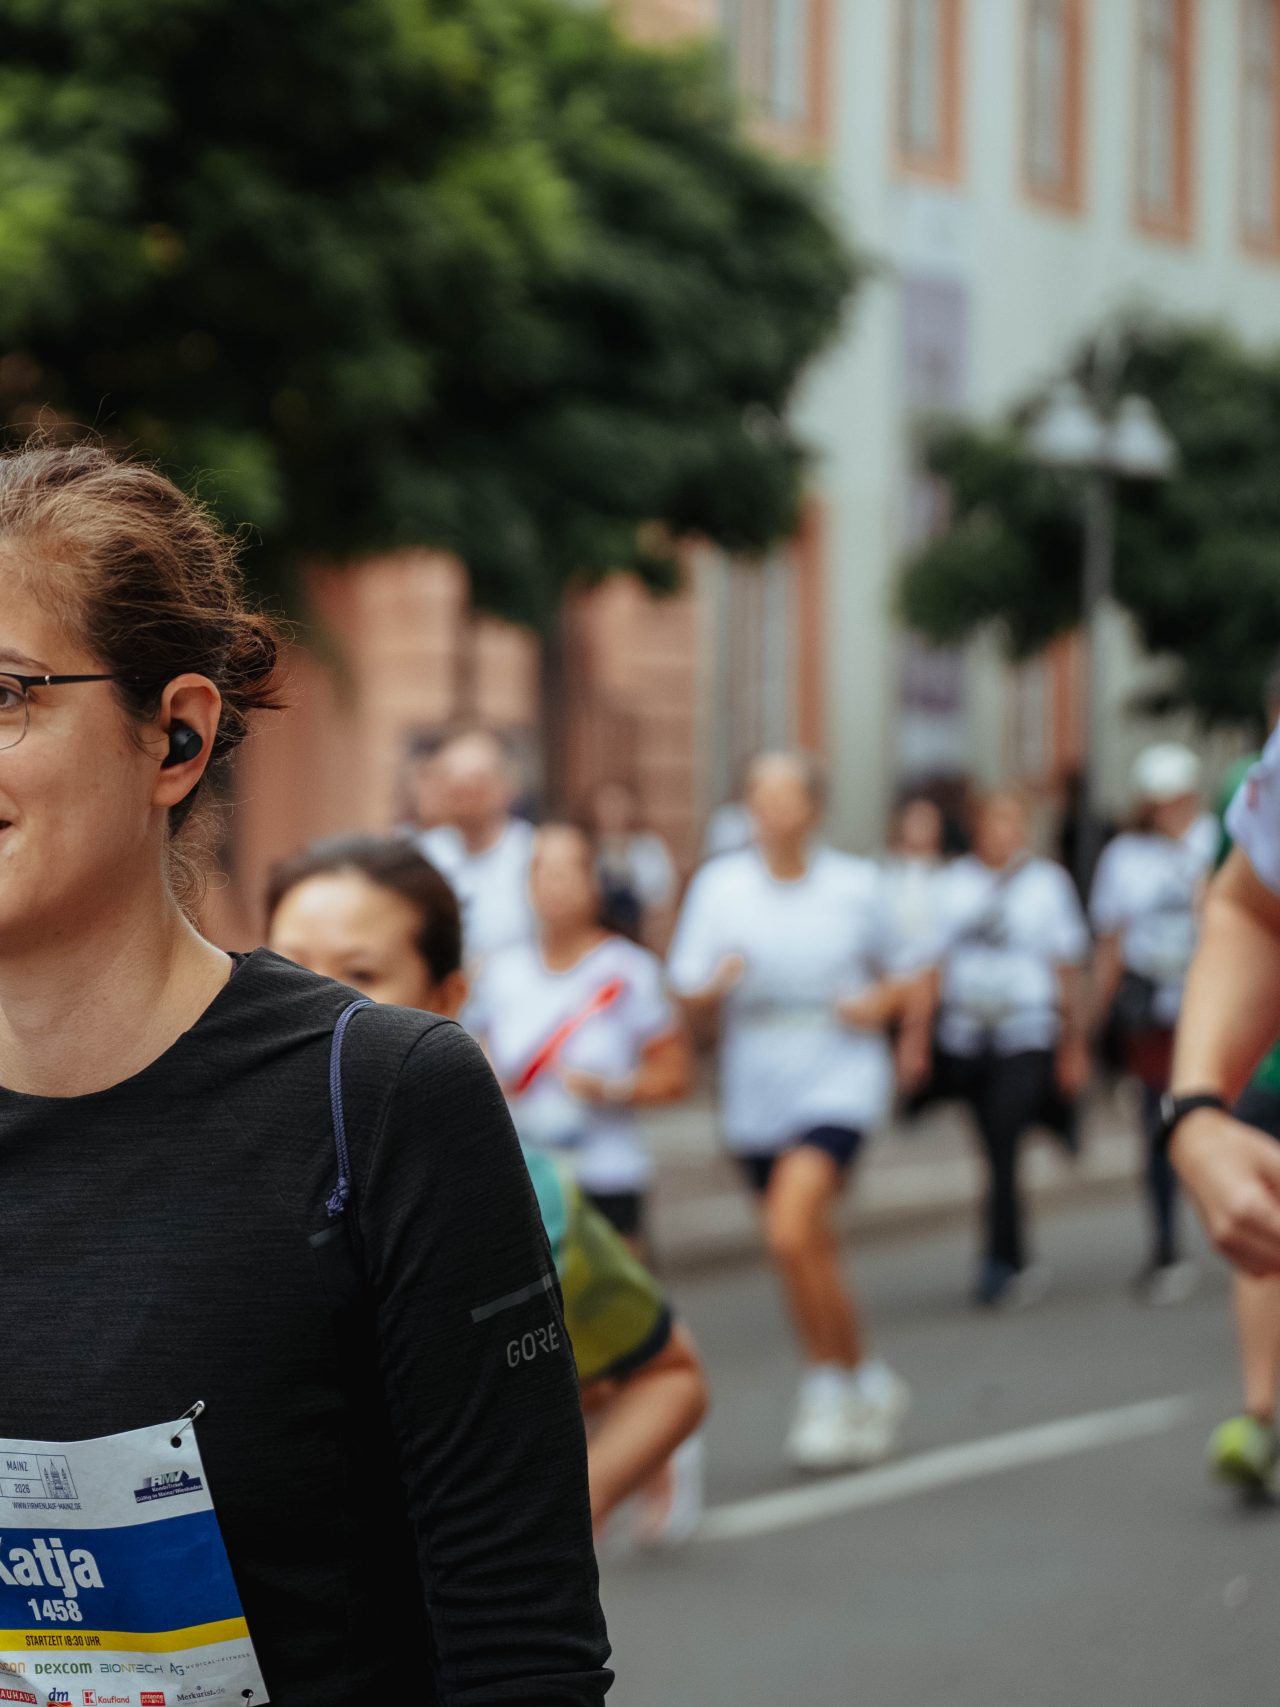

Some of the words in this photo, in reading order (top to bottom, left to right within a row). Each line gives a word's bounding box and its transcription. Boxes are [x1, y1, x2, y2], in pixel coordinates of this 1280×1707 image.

[506, 1322, 560, 1368] GORE
[6, 1460, 29, 1472] MAINZ
[150, 1470, 184, 1487] RMV
[27, 1598, 83, 1622] 1458
[25, 1635, 63, 1646] STARTZEIT
[64, 1635, 84, 1646] 18:30
[85, 1636, 101, 1646] UHR
[48, 1687, 69, 1702] dm
[98, 1695, 130, 1704] Kaufland
